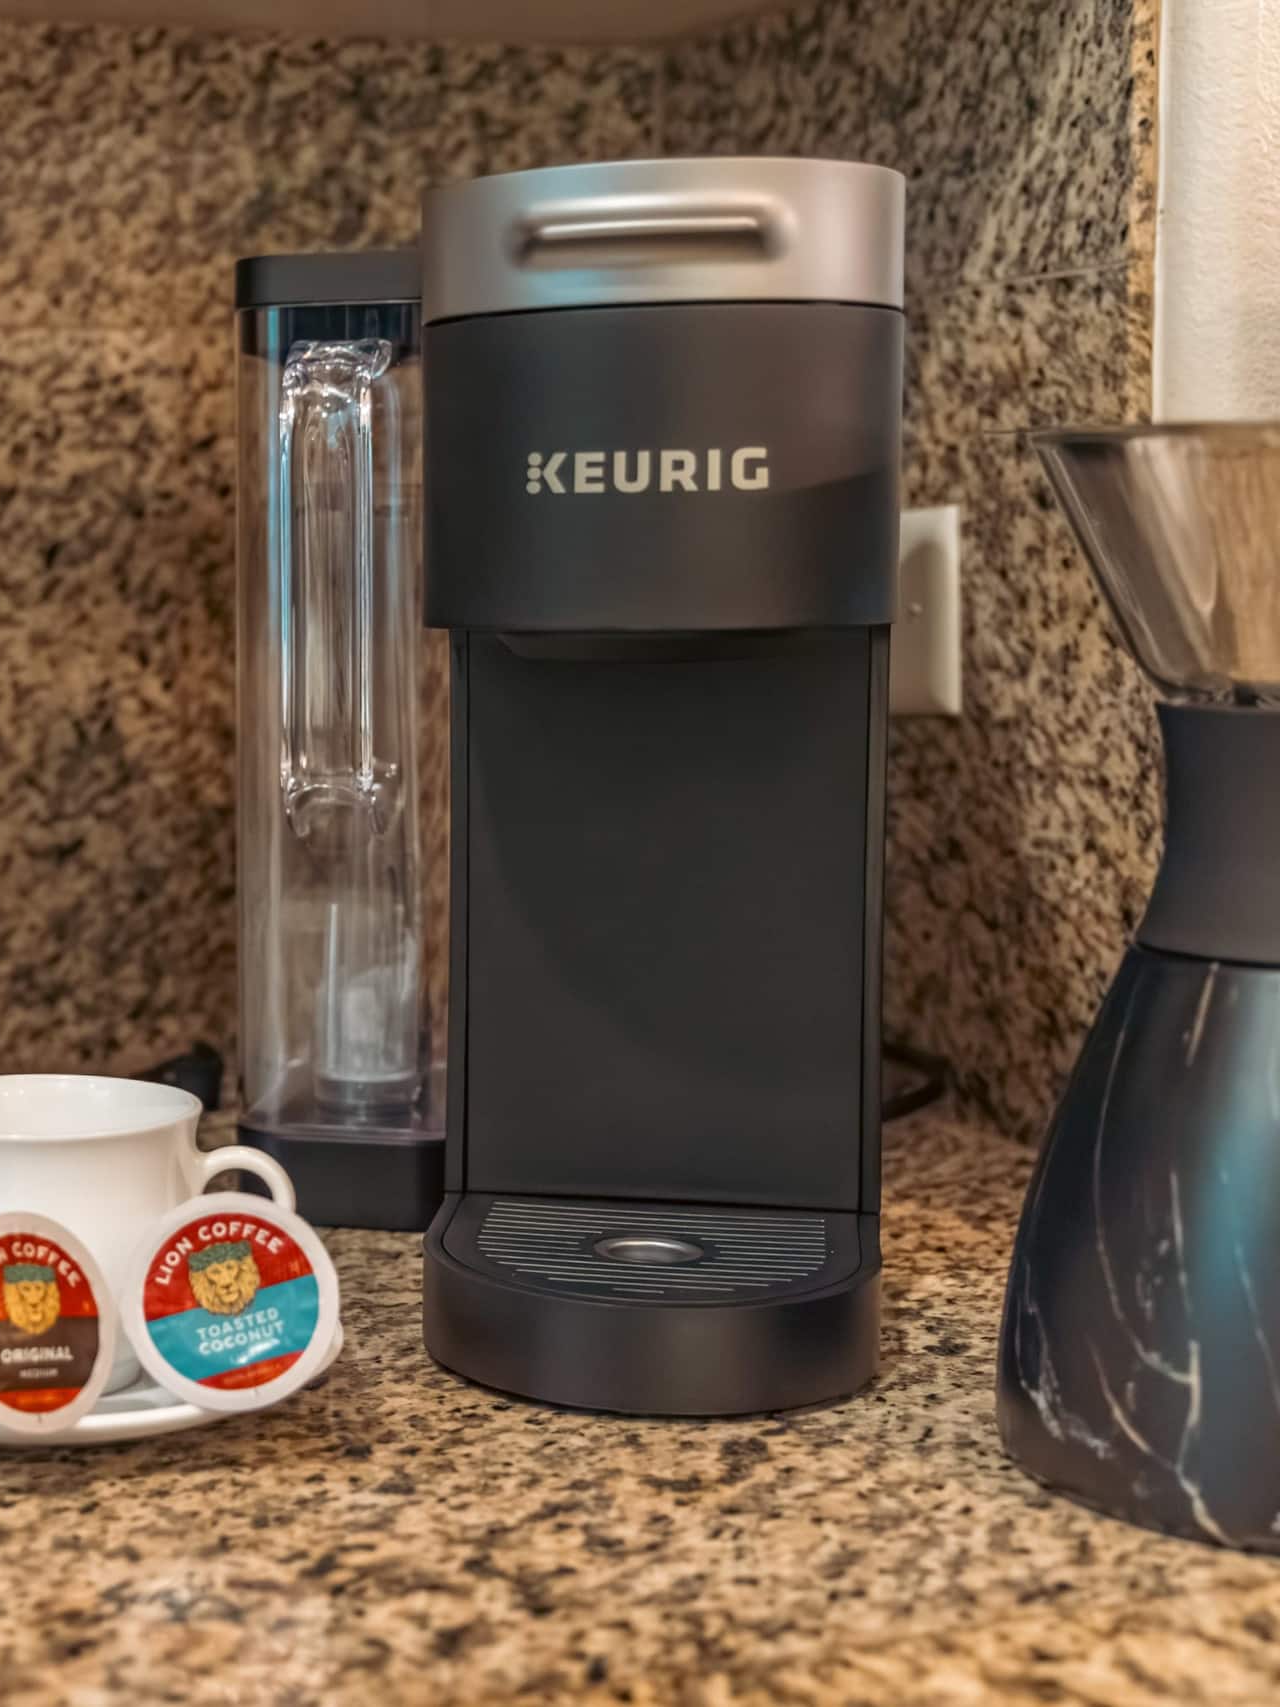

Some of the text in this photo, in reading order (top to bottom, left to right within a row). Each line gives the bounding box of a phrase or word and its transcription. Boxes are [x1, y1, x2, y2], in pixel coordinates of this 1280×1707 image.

[526, 447, 769, 494] KEURIG
[11, 1240, 81, 1288] COFFEE
[154, 1221, 284, 1285] LION COFFEE
[197, 1307, 279, 1340] TOASTED
[198, 1320, 284, 1356] COCONUT
[0, 1346, 74, 1365] ORIGINAL
